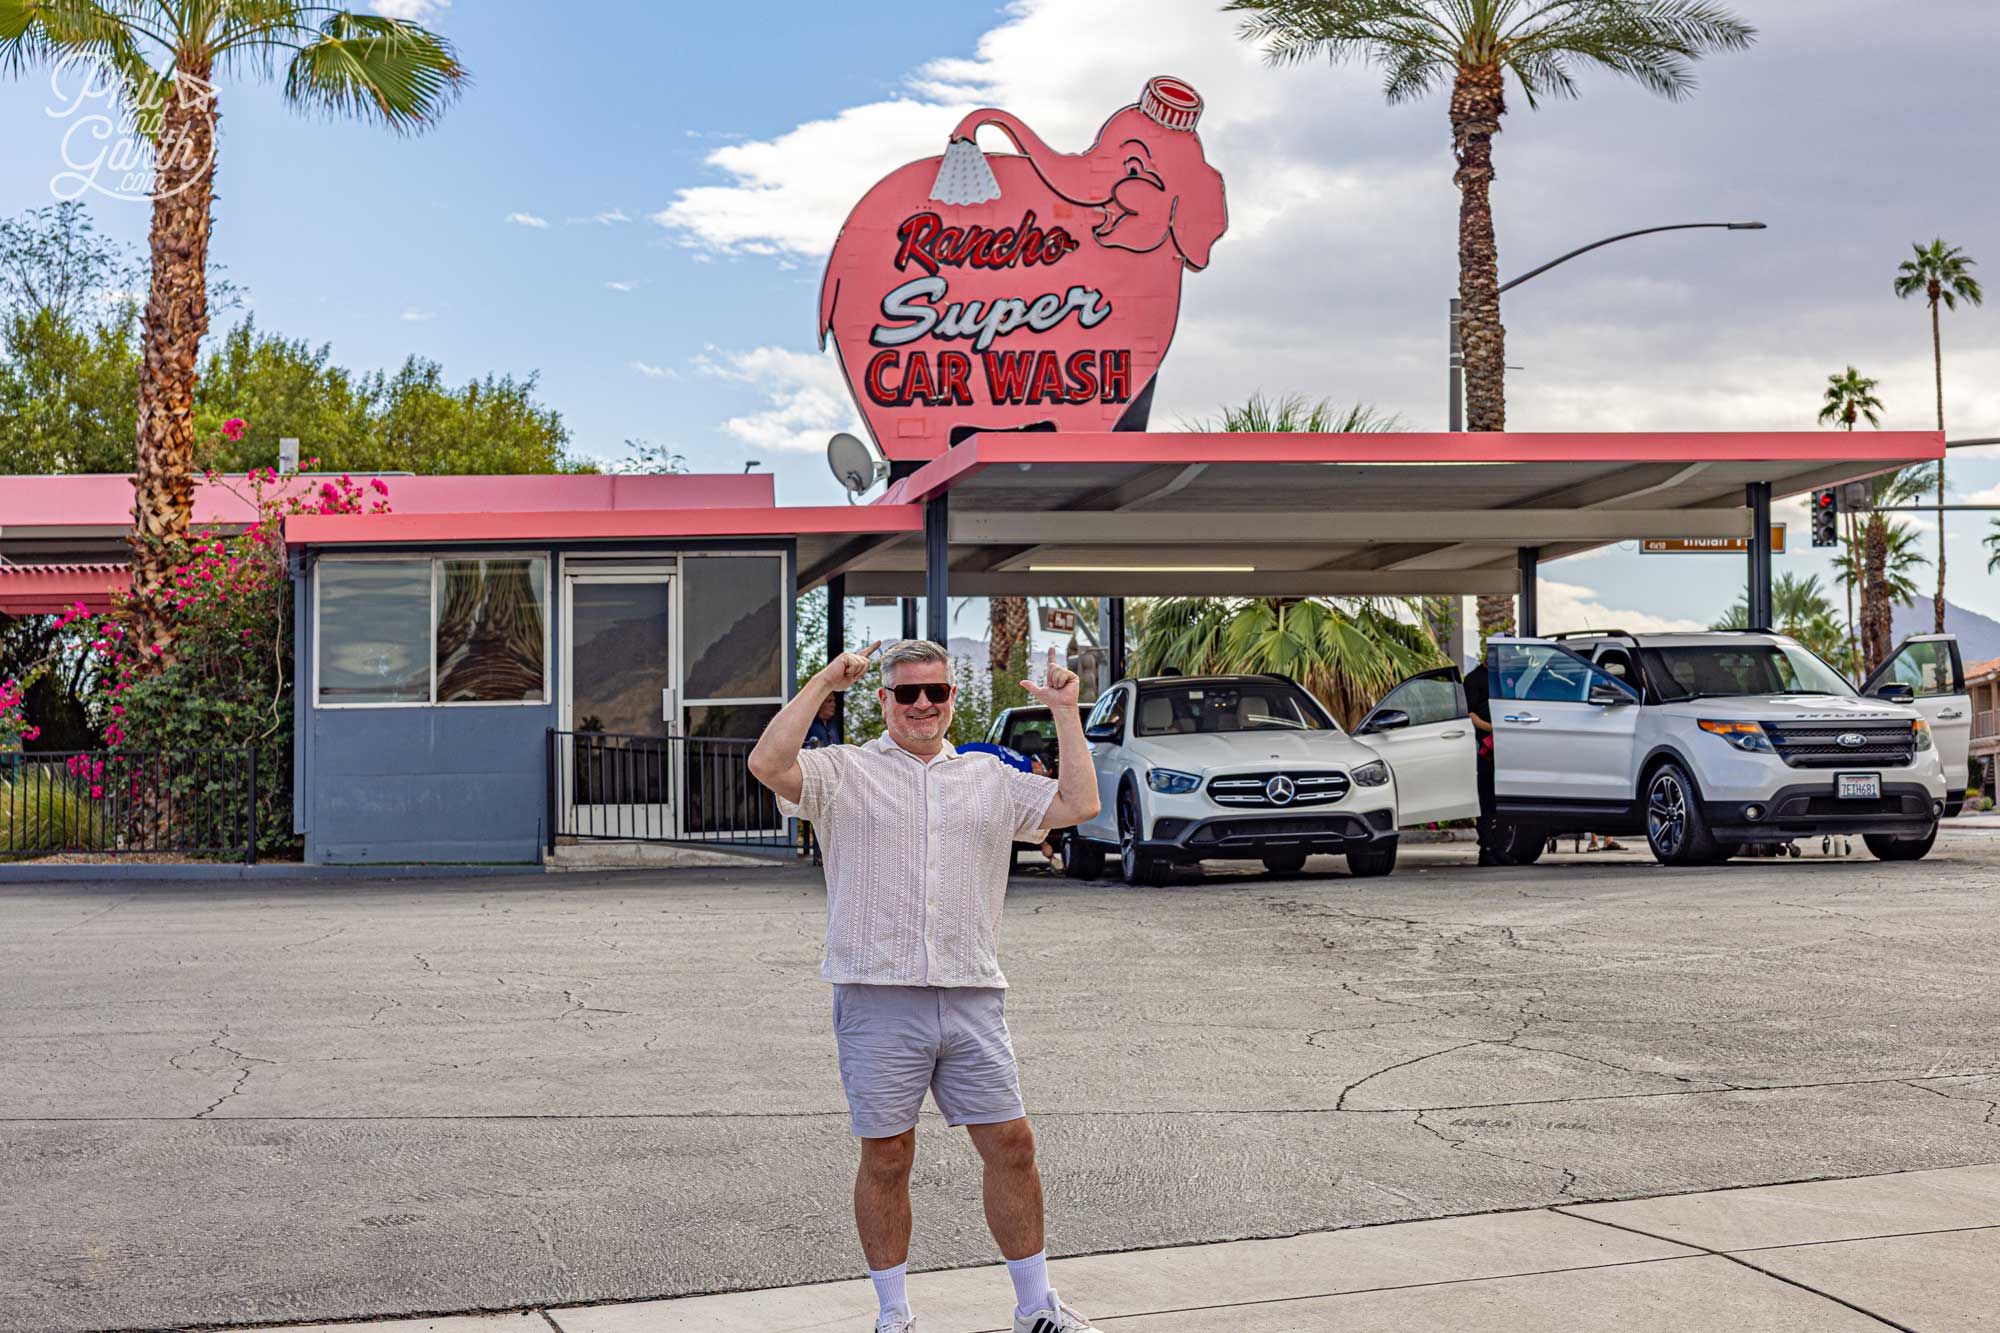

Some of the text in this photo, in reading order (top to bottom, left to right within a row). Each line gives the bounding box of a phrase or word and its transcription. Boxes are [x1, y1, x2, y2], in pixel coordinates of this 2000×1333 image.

[895, 209, 1080, 275] Rancho
[869, 276, 1112, 352] Super
[864, 350, 1132, 407] CAR WASH
